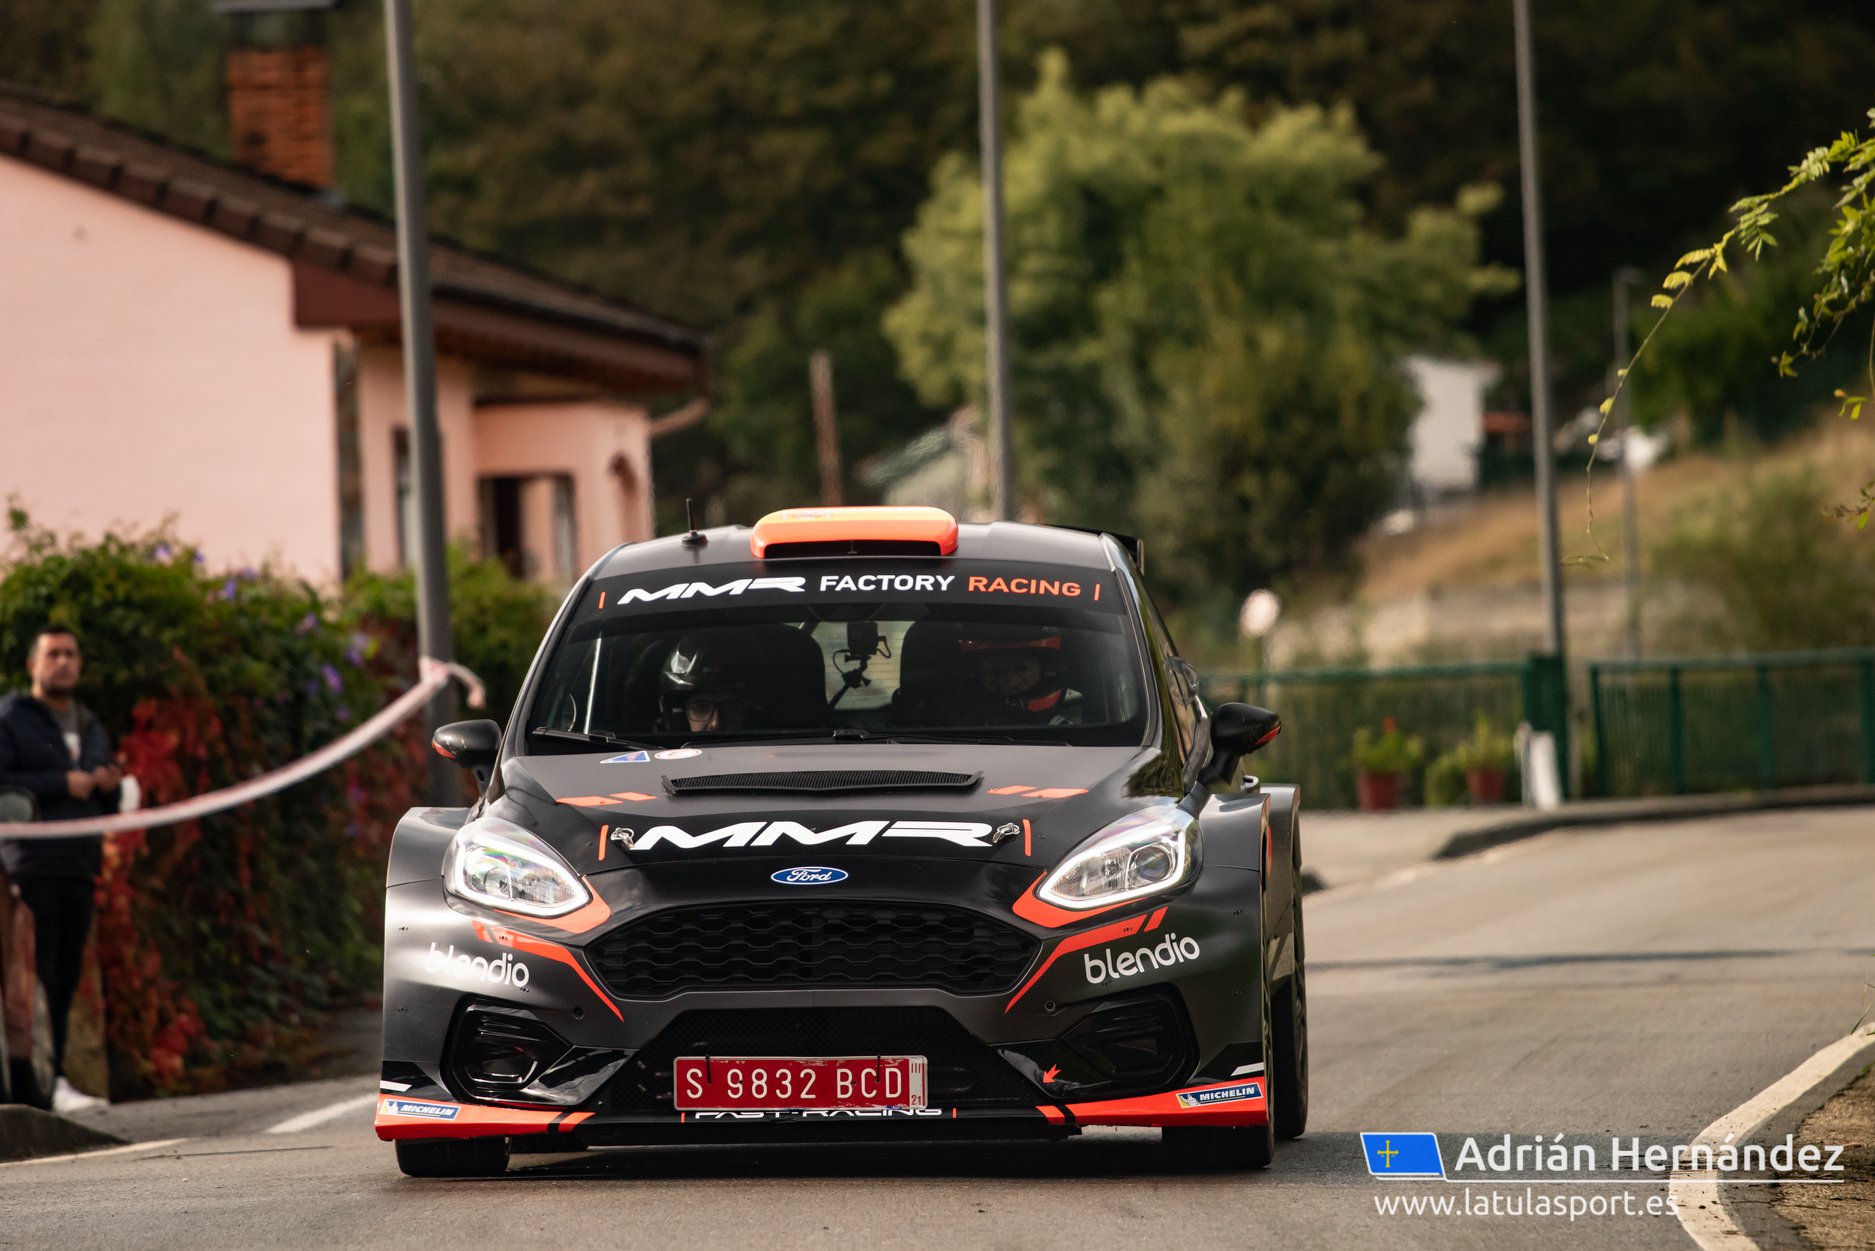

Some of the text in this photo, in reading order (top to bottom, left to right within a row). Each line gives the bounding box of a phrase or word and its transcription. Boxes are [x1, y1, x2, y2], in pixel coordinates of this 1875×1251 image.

[617, 575, 1081, 605] MMR FACTORY RACING
[629, 820, 993, 850] MMR
[786, 867, 832, 882] Ford
[1083, 932, 1200, 984] blendio
[686, 1067, 902, 1099] S 9832 BCD
[1199, 1087, 1255, 1101] MICHELIN
[400, 1104, 455, 1116] MICHELIN
